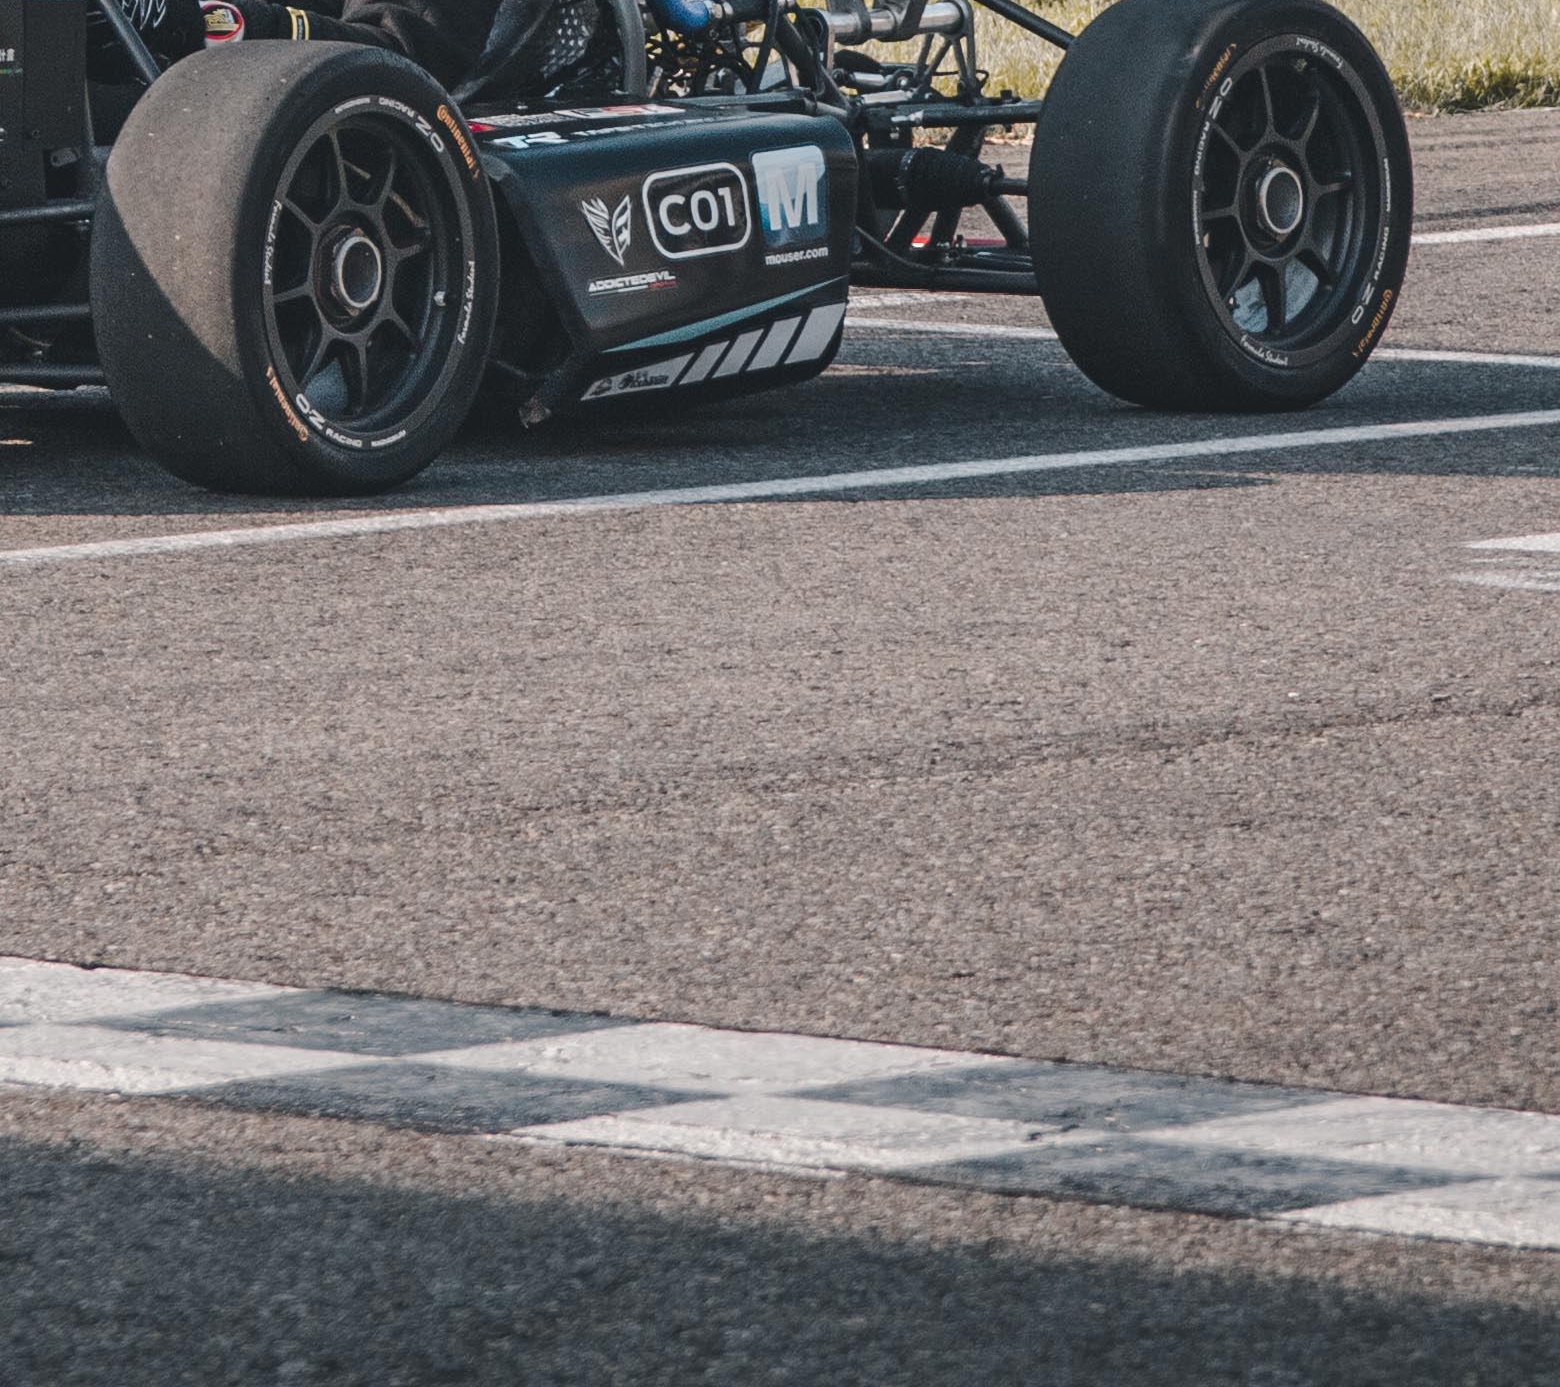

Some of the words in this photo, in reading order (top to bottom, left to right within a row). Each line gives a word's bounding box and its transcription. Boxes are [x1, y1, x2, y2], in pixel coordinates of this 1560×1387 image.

[658, 186, 737, 236] C01
[766, 161, 820, 232] M
[765, 246, 829, 266] mouser.com
